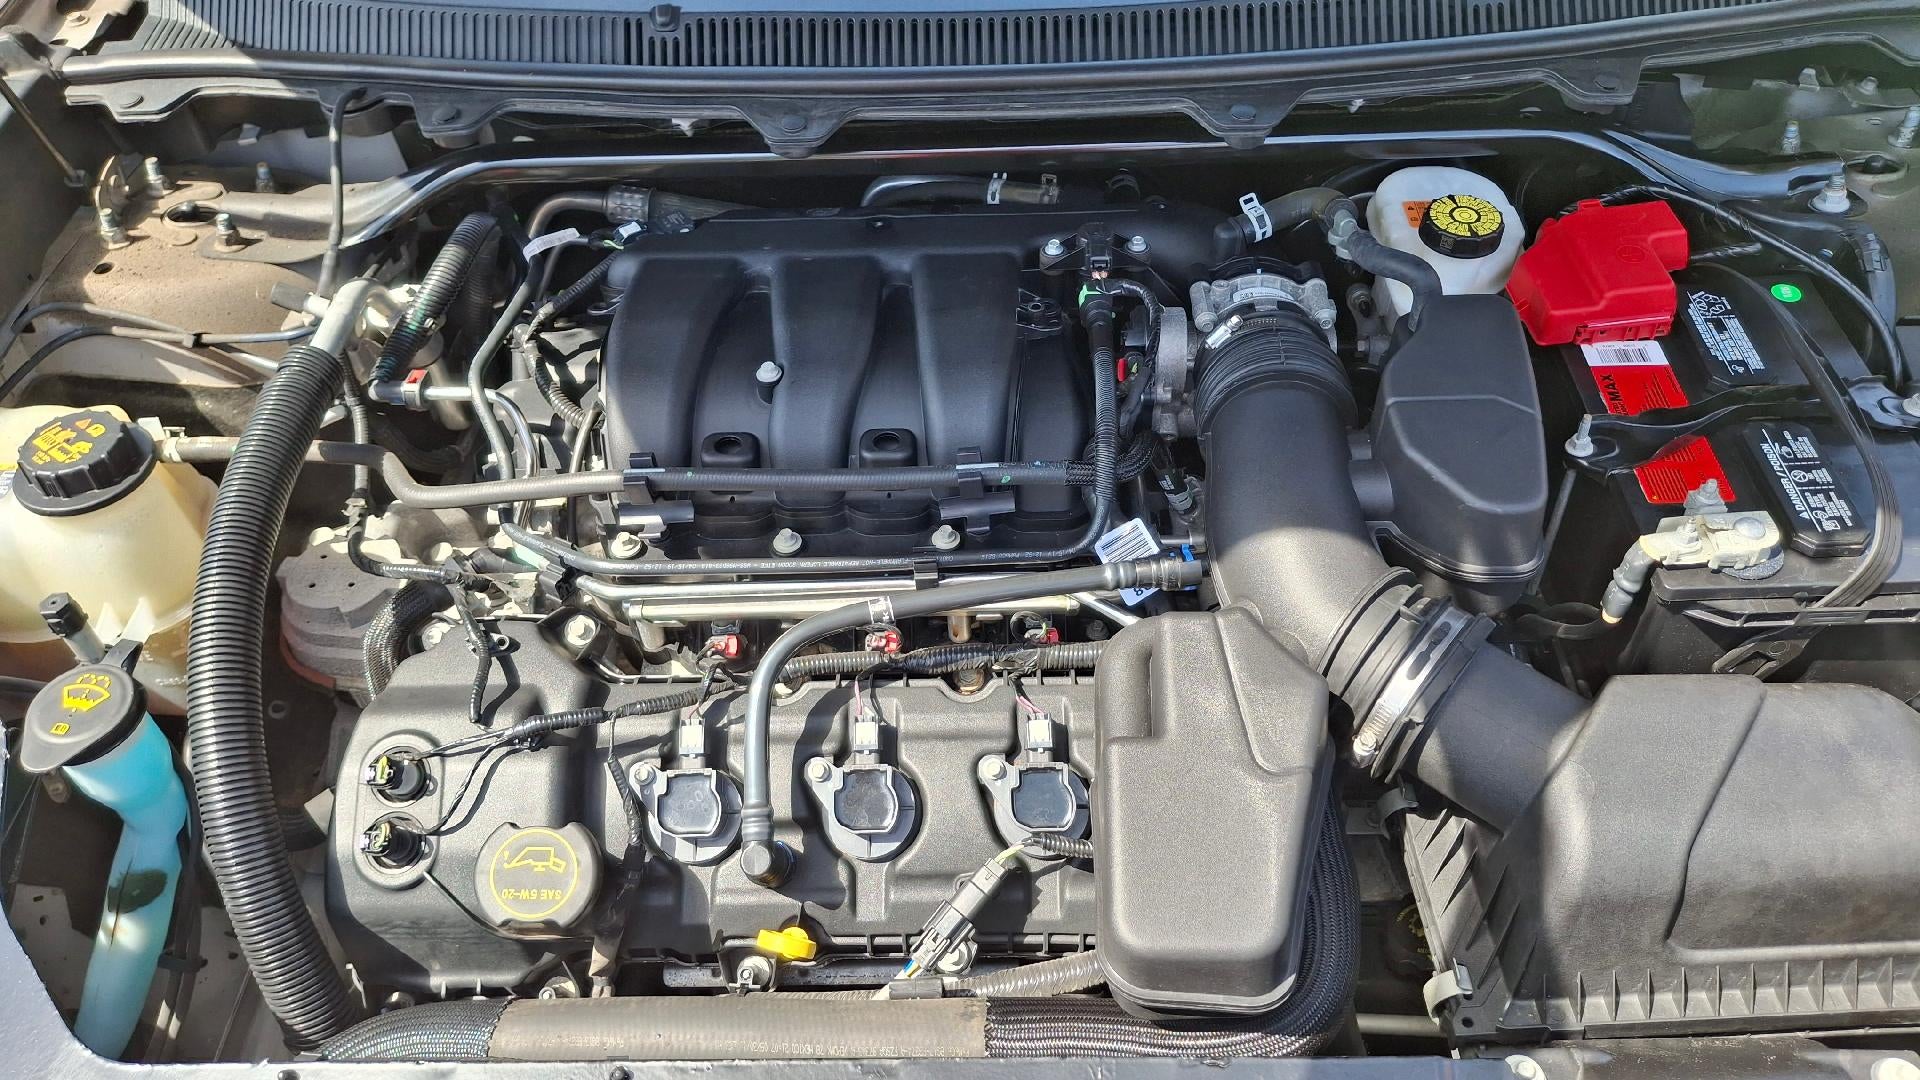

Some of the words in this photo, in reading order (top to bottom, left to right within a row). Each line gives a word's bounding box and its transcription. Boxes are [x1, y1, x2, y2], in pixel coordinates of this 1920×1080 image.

[1600, 374, 1622, 402] MAX
[1760, 443, 1784, 471] POISON
[1781, 478, 1805, 511] DANGER
[501, 888, 538, 900] 5W-20
[540, 888, 562, 900] SAE
